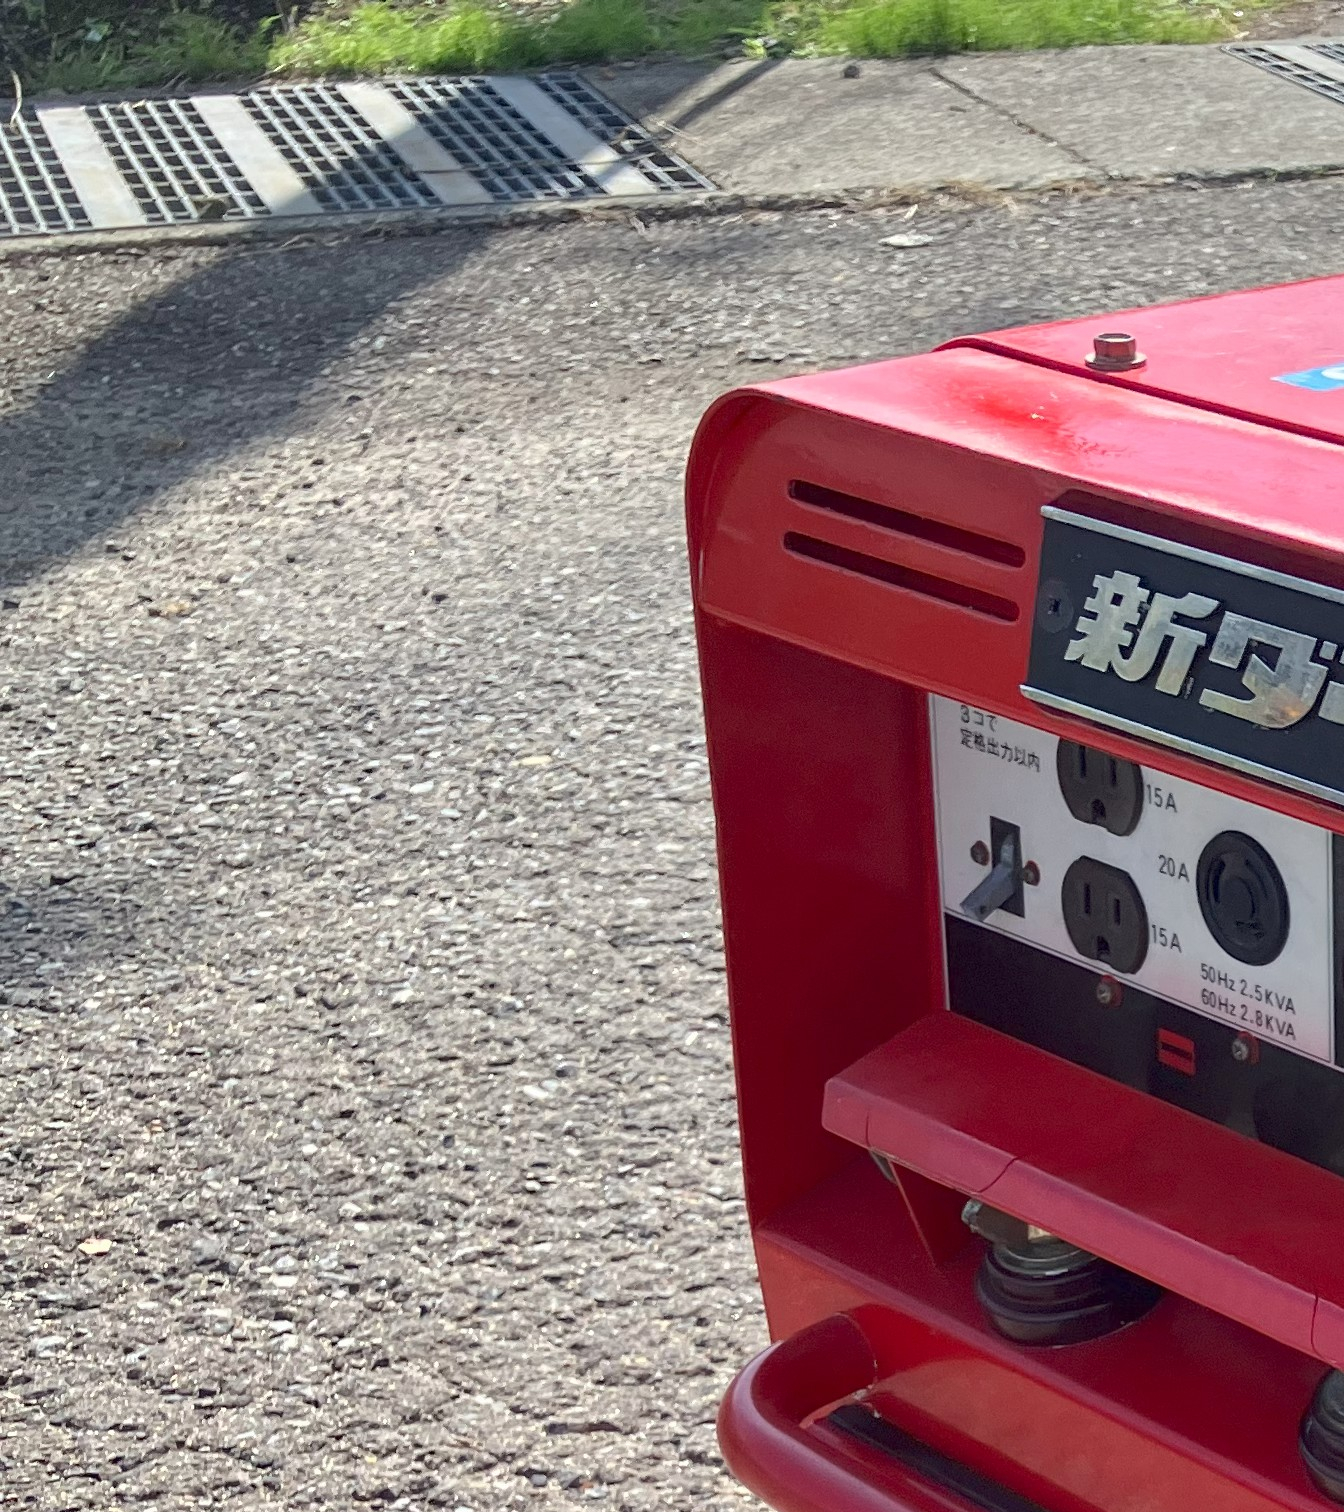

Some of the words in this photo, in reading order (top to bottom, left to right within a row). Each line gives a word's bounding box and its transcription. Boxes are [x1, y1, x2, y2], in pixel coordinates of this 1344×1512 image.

[1146, 784, 1178, 813] 15A
[1158, 854, 1190, 882] 20A
[1151, 924, 1183, 953] 15A
[1200, 962, 1236, 993] 50Hz
[1239, 978, 1297, 1015] 2.5KVA
[1200, 988, 1237, 1018] 60Hz
[1239, 1004, 1297, 1041] 2.8KVA
